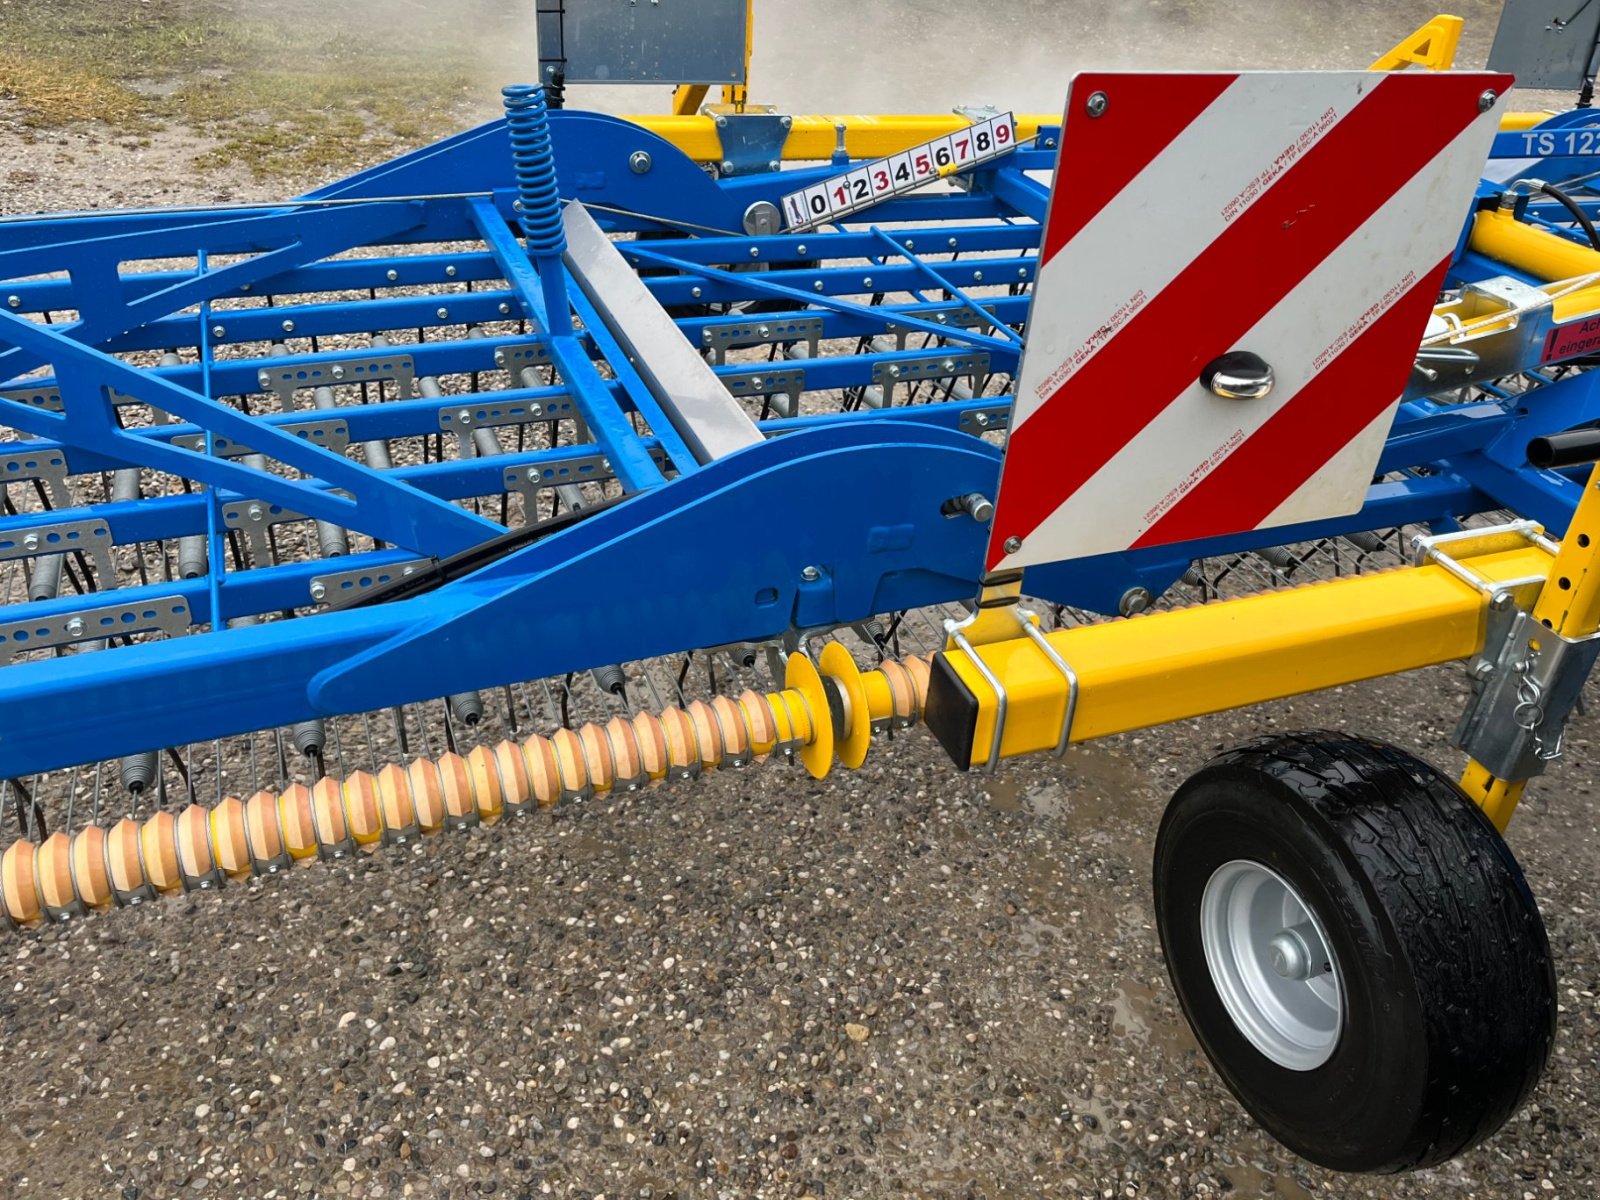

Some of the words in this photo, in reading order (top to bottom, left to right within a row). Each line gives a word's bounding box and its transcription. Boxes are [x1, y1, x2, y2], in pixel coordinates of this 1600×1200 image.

[1321, 107, 1334, 122] DIN
[1300, 122, 1319, 142] 11030
[1522, 132, 1555, 156] TS
[1273, 144, 1295, 165] GEKA
[1224, 208, 1238, 222] DIN
[1239, 188, 1258, 208] 11030
[1262, 165, 1284, 185] GEKA
[1401, 270, 1414, 283] DIN
[1130, 289, 1143, 302] DIN
[1359, 303, 1379, 322] GEKA
[1315, 358, 1327, 370] DIN
[1349, 320, 1369, 338] GEKA
[1039, 386, 1052, 399] DIN
[1076, 345, 1096, 364] GEKA
[1230, 428, 1243, 441] DIN
[1189, 460, 1209, 477] GEKA
[1147, 512, 1159, 524] DIN
[1180, 476, 1199, 494] GEKA
